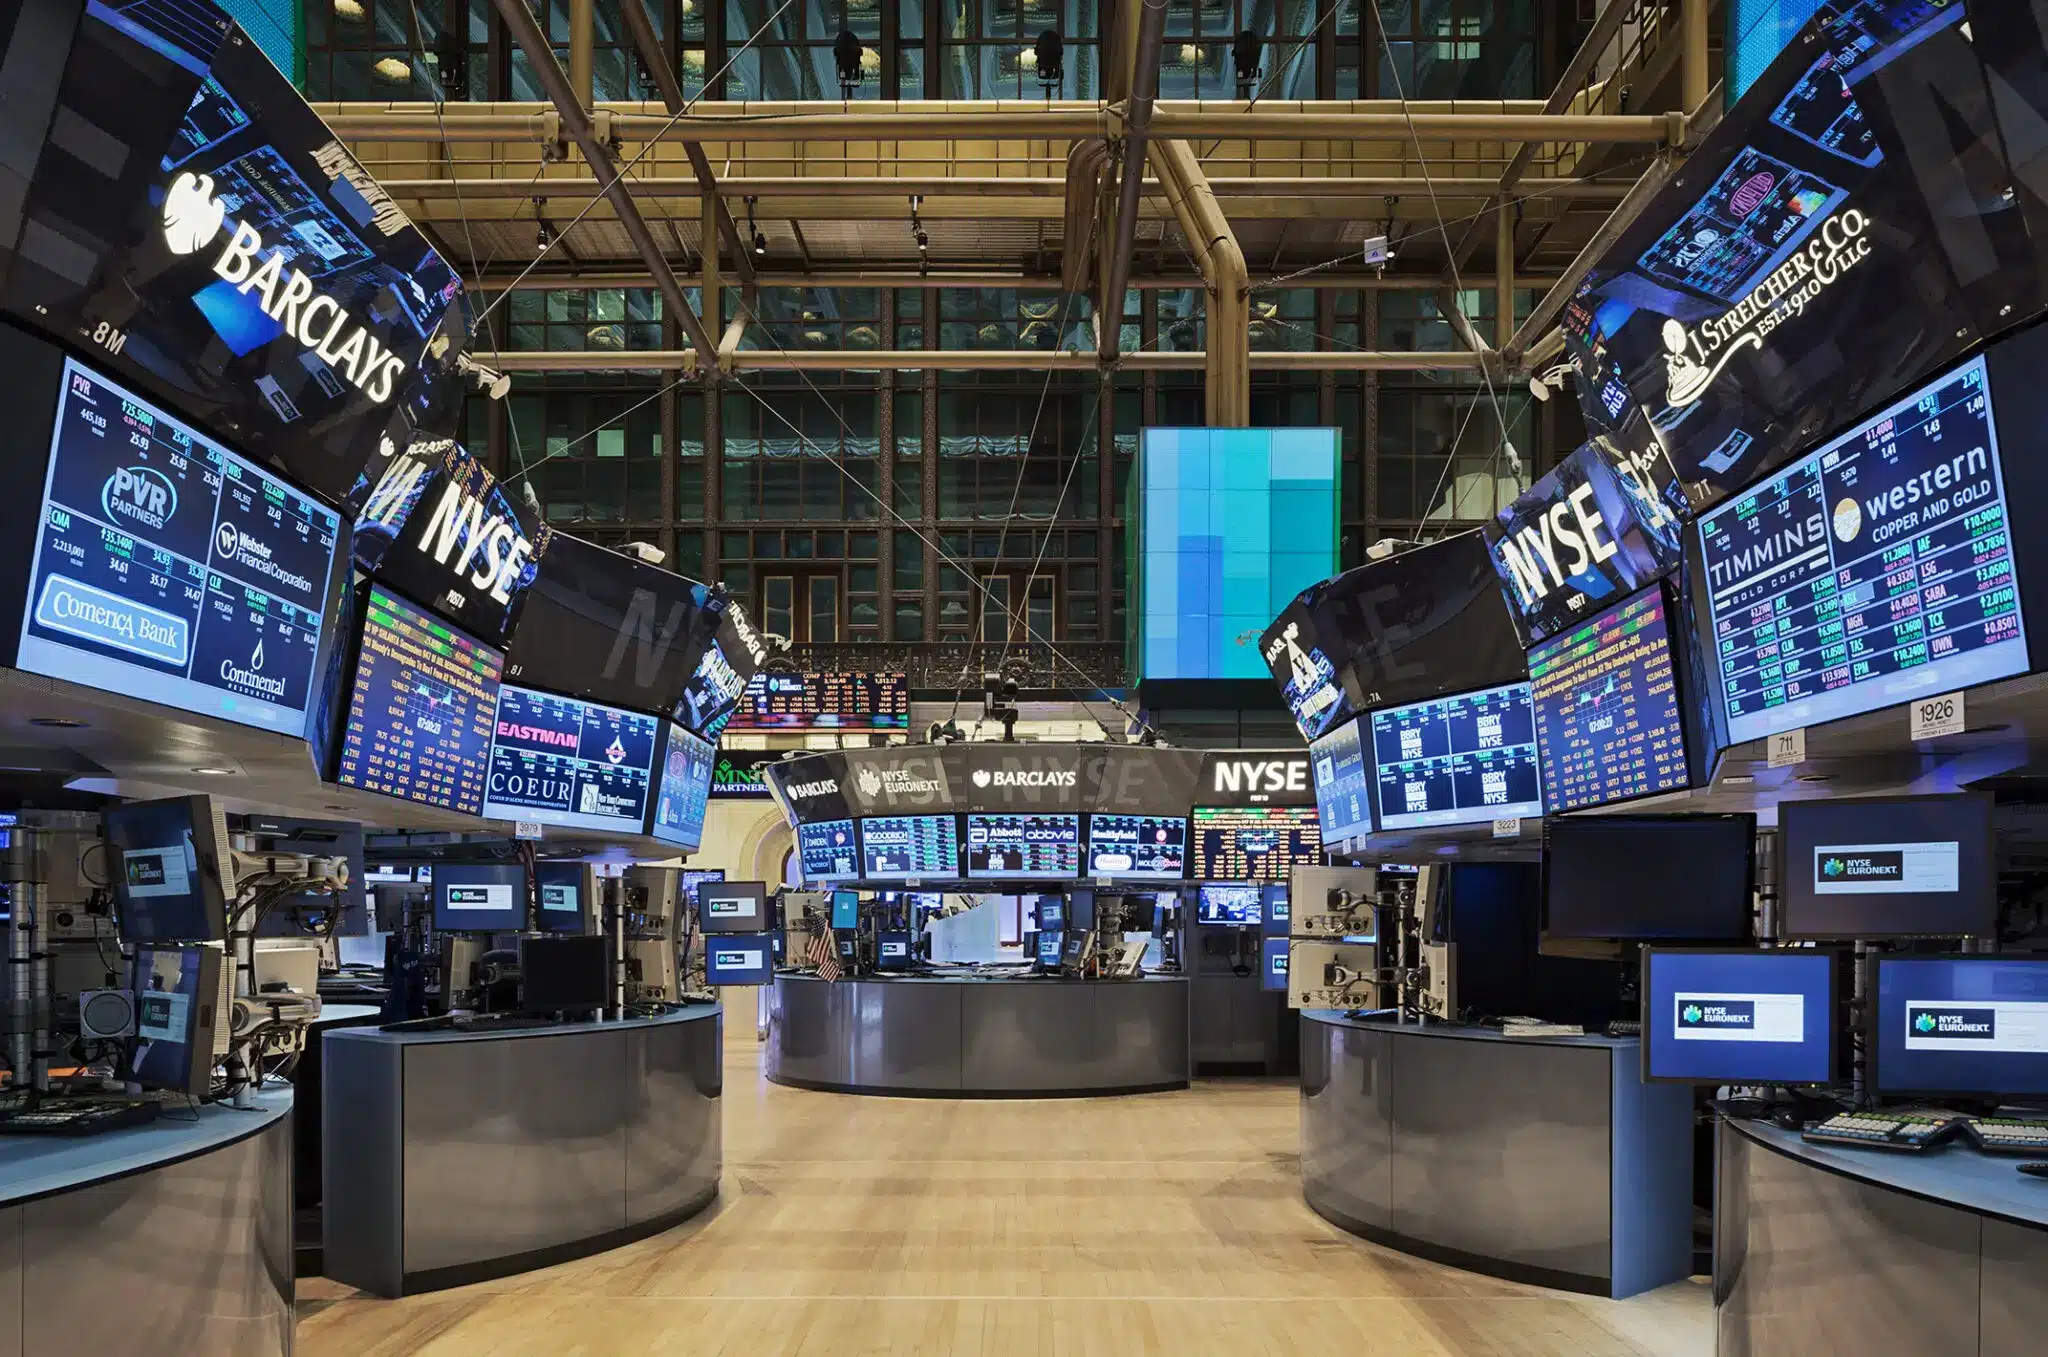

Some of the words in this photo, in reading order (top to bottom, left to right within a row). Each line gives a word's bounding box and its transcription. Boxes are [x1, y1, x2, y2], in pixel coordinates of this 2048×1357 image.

[1837, 237, 1871, 272] LLC
[213, 219, 405, 403] BARCLAYS
[92, 321, 127, 356] 8M
[73, 375, 91, 395] PVR
[1962, 375, 1980, 389] 2.00
[1919, 396, 1935, 413] 0.91
[1967, 396, 1984, 414] 1.40
[80, 409, 106, 428] 445,183
[1871, 419, 1893, 439] 1.4000
[1924, 419, 1940, 436] 1.43
[130, 432, 149, 450] 25.93
[1882, 443, 1896, 458] 1.41
[170, 453, 187, 470] 25.93
[1822, 450, 1840, 469] WRN
[228, 462, 242, 479] WBS
[113, 467, 166, 516] PVR
[1866, 446, 1987, 520] western
[51, 510, 69, 528] CMA
[111, 496, 164, 529] PARTNERS
[1873, 512, 1919, 543] COPPER
[1922, 498, 1948, 522] AND
[1953, 479, 1991, 508] GOLD
[1971, 506, 2001, 528] 10.9000
[106, 531, 133, 550] 35.1400
[239, 531, 272, 559] Webster
[418, 480, 533, 606] NYSE
[1502, 482, 1618, 606] NYSE
[1917, 536, 1931, 552] IAF
[1978, 534, 2005, 554] 0.7836
[1710, 513, 1825, 586] TIMMINS
[110, 558, 128, 574] 34.61
[236, 547, 272, 575] Financial
[271, 562, 312, 593] Corporation
[1921, 561, 1937, 577] LSG
[1982, 561, 2009, 580] 3.0500
[150, 573, 168, 588] 35.17
[1733, 585, 1763, 604] GOLD
[1771, 567, 1804, 588] CORP
[1925, 585, 1947, 602] SARA
[1986, 588, 2013, 607] 2.0100
[1846, 614, 1863, 630] MGH
[1928, 612, 1944, 627] TCX
[1990, 615, 2017, 634] 0.8501
[138, 617, 178, 648] Bank
[1850, 639, 1864, 652] TAS
[1932, 636, 1953, 652] UWN
[1854, 661, 1869, 676] EPM
[221, 659, 286, 696] Continental
[228, 683, 275, 701] RESOURCES
[1920, 700, 1954, 722] 1926
[1477, 714, 1501, 727] BBRY
[498, 721, 578, 748] EASTMAN
[1400, 728, 1421, 740] BBRY
[1479, 735, 1502, 748] NYSE
[1779, 736, 1793, 752] 711
[1402, 749, 1423, 759] NYSE
[882, 770, 908, 781] NYSE
[993, 771, 1076, 786] BARCLAYS
[1214, 760, 1308, 792] NYSE
[1482, 771, 1505, 784] BBRY
[491, 773, 569, 800] COEUR
[797, 779, 838, 797] BARCLAYS
[1405, 781, 1426, 792] BBRY
[538, 800, 567, 808] CORPORATION
[1407, 801, 1428, 812] NYSE
[1484, 793, 1507, 804] NYSE
[519, 822, 538, 833] 3979
[990, 828, 1022, 837] Abbott
[1497, 820, 1516, 829] 3223
[872, 831, 908, 839] GOODRICH
[1026, 830, 1074, 840] abbvie
[1092, 830, 1137, 842] Smithfield
[1847, 859, 1871, 867] NYSE
[1848, 866, 1898, 875] EURONEXT.
[1704, 1006, 1726, 1015] NYSE
[1939, 1015, 1963, 1024] NYSE
[1939, 1023, 1990, 1032] EURONEXT.
